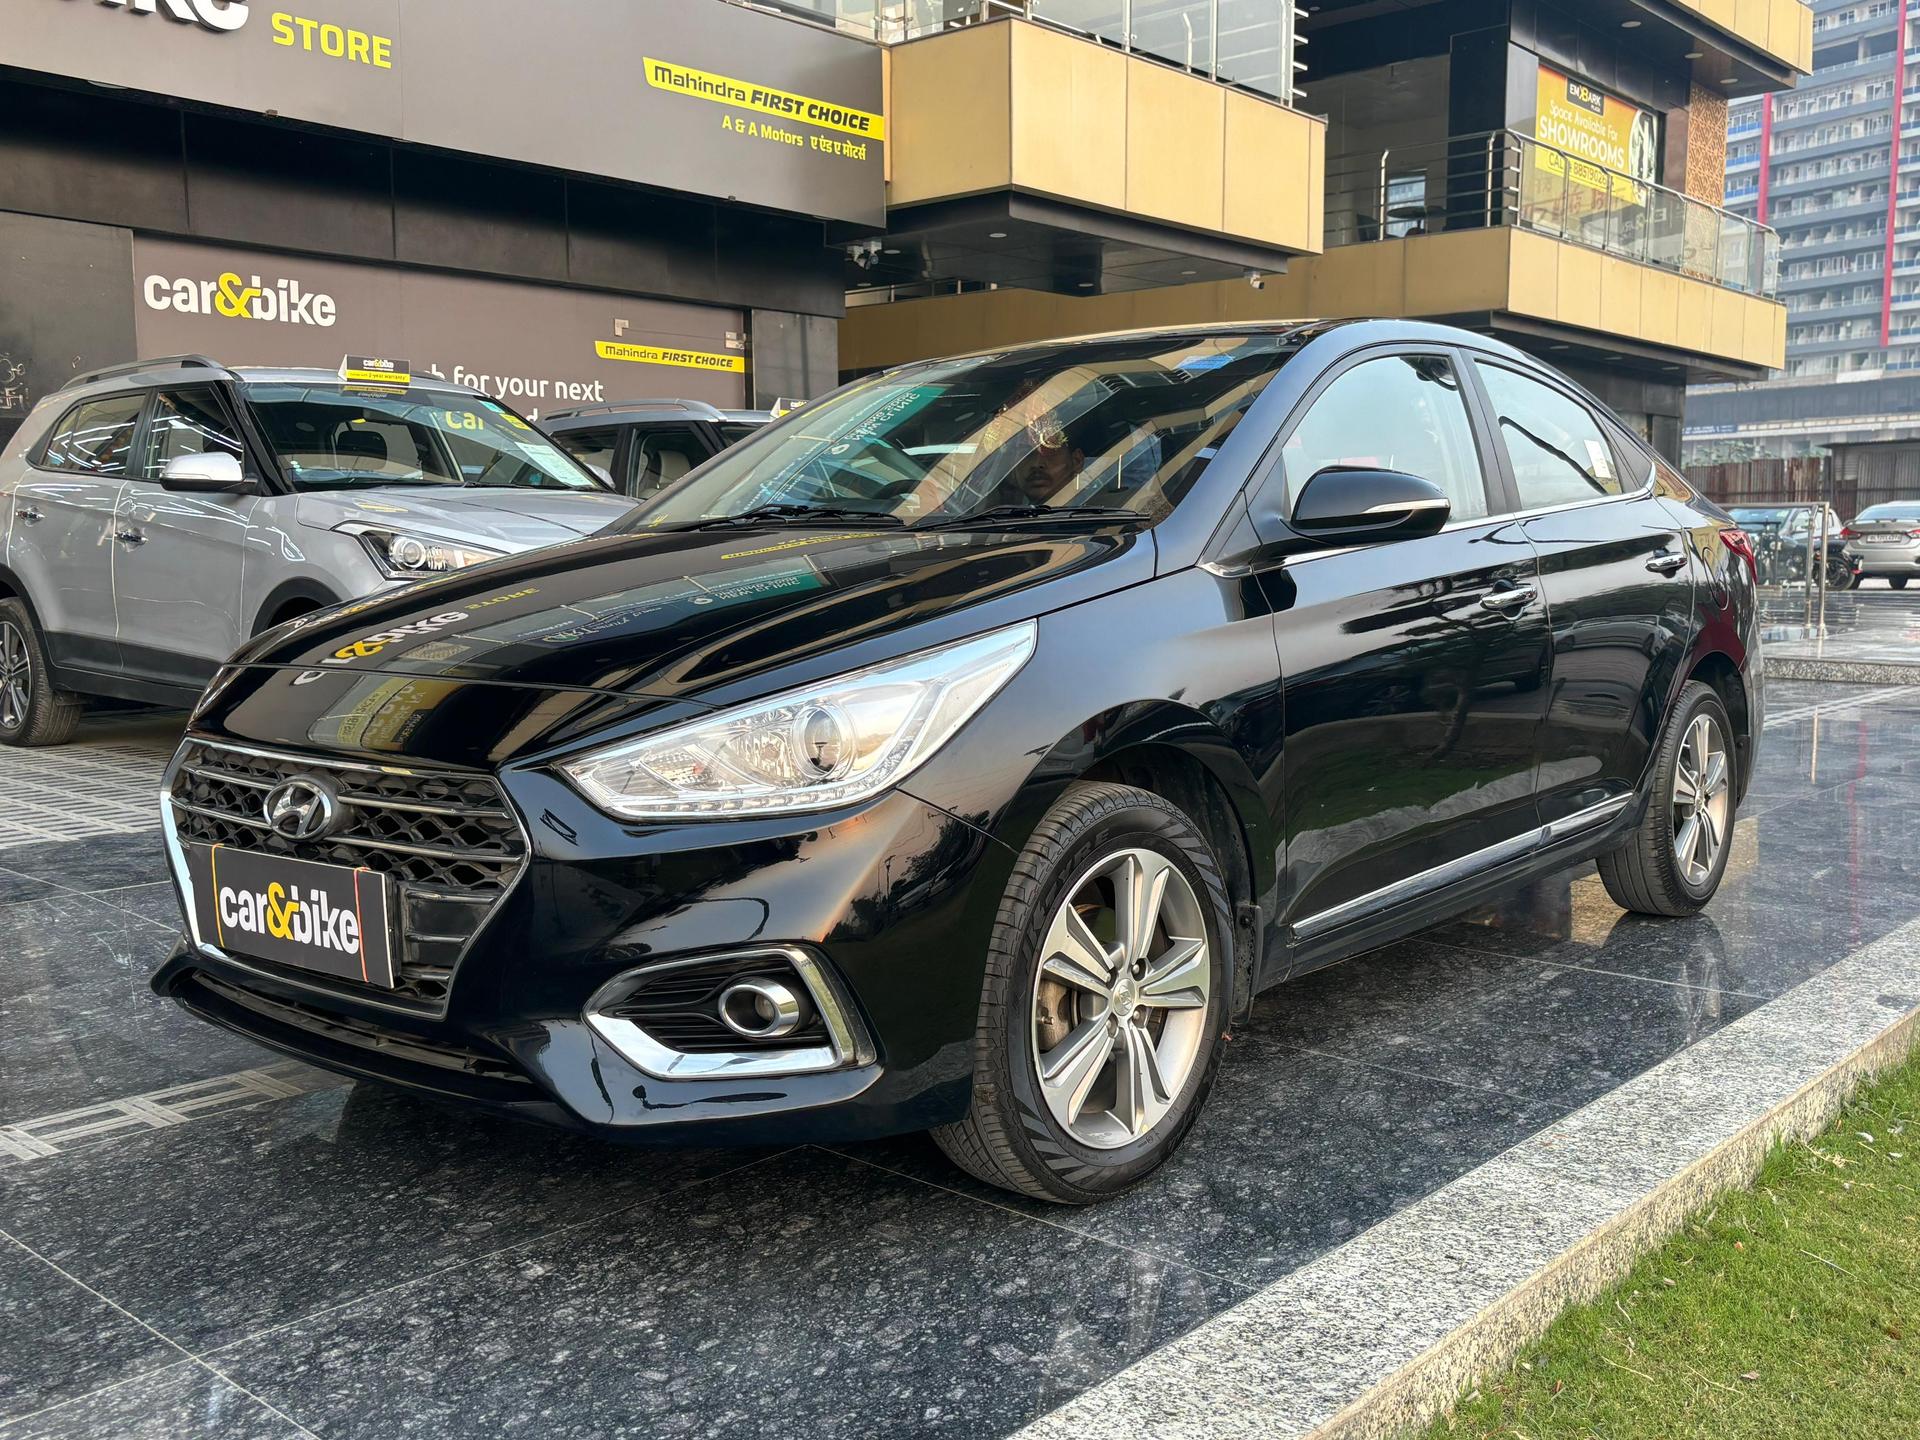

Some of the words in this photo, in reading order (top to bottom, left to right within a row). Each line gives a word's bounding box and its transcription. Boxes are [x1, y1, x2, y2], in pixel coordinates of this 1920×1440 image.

[271, 12, 392, 69] STORE
[654, 65, 746, 102] Mahindra
[750, 89, 804, 115] FIRST
[807, 103, 870, 131] CHOICE
[1549, 100, 1573, 122] Space
[1575, 112, 1606, 137] Available
[1608, 124, 1618, 141] For
[721, 115, 732, 131] A
[735, 119, 746, 134] &
[748, 121, 758, 137] A
[761, 124, 804, 147] Motors
[1539, 115, 1625, 169] SHOWROOMS
[144, 272, 336, 327] car&bike
[453, 366, 490, 395] for
[495, 376, 550, 399] your
[555, 381, 604, 401] next
[605, 345, 659, 360] Mahindra
[661, 351, 694, 363] FIRST
[695, 355, 733, 368] CHOICE
[219, 882, 359, 955] car&bike
